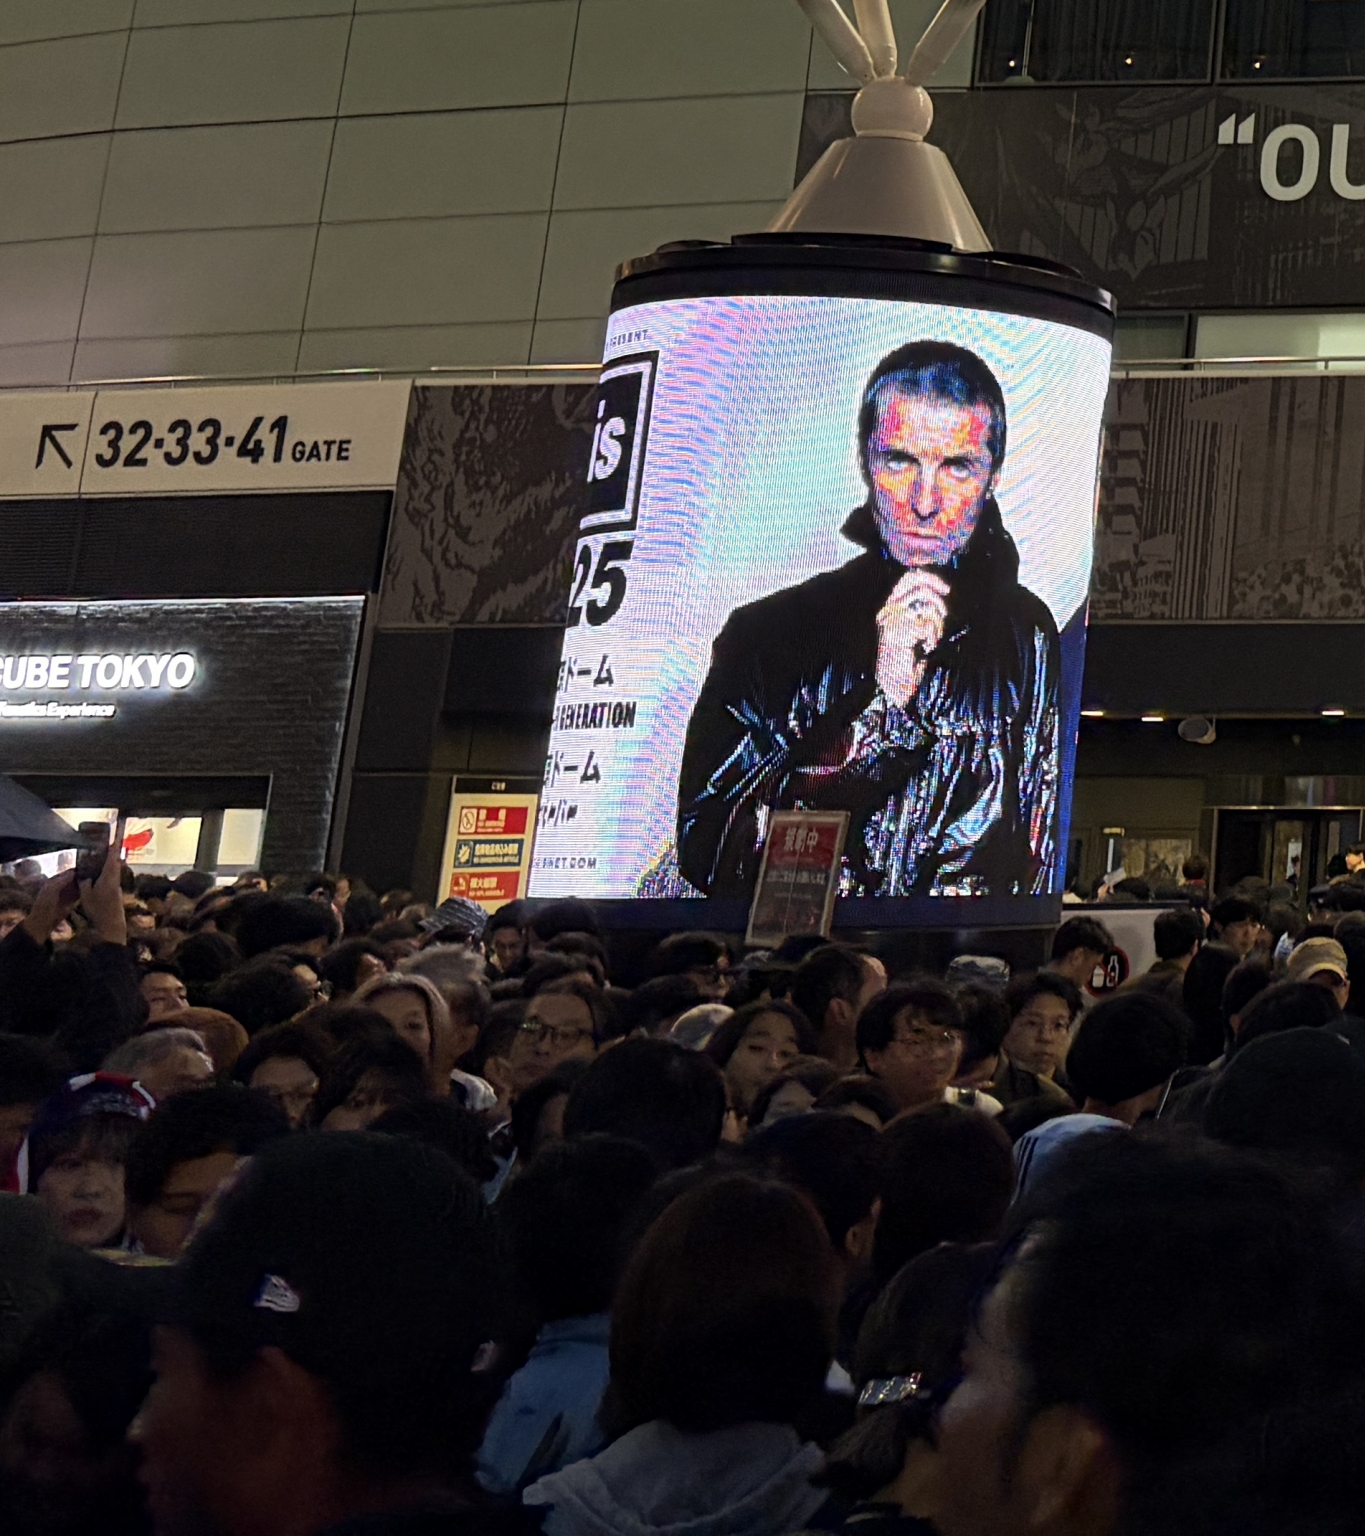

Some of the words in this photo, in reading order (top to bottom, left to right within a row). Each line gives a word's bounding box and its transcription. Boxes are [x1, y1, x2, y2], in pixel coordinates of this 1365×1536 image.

[291, 439, 352, 463] GATE
[0, 654, 73, 689] UBE
[77, 653, 196, 689] TOKYO
